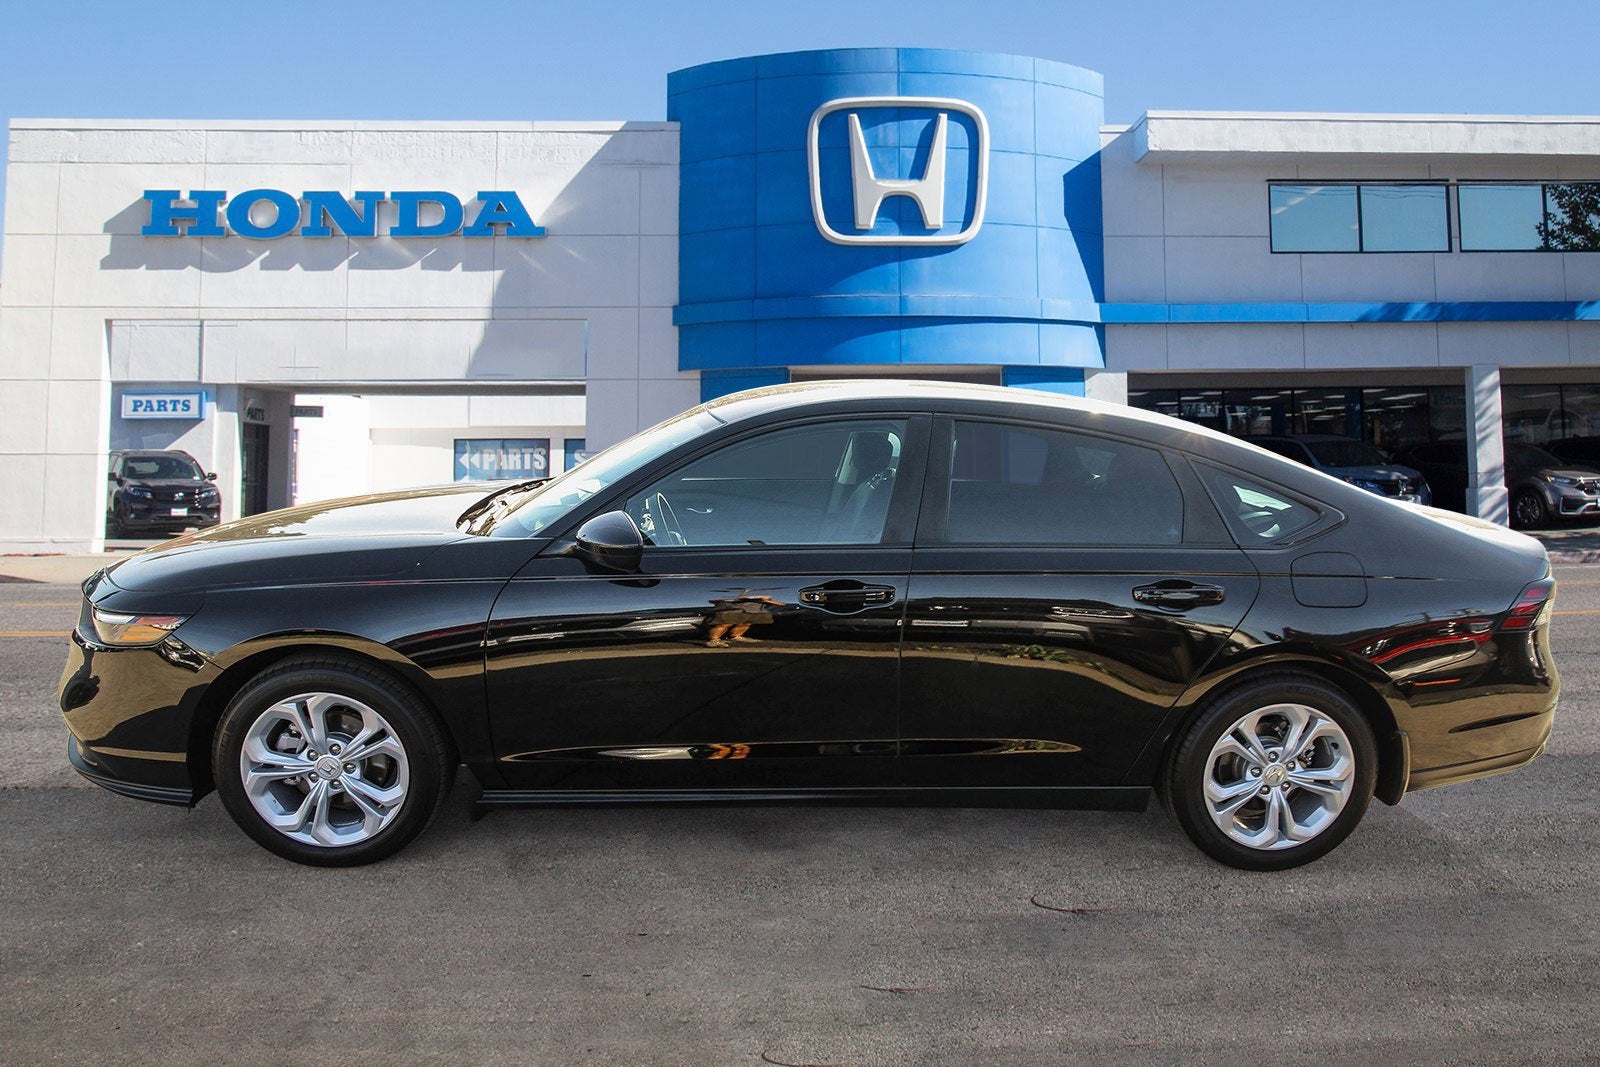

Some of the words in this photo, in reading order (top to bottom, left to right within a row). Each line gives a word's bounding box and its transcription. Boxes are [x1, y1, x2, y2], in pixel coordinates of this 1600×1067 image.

[142, 188, 547, 240] HONDA
[132, 399, 191, 412] PARTS
[483, 447, 546, 470] PARTS
